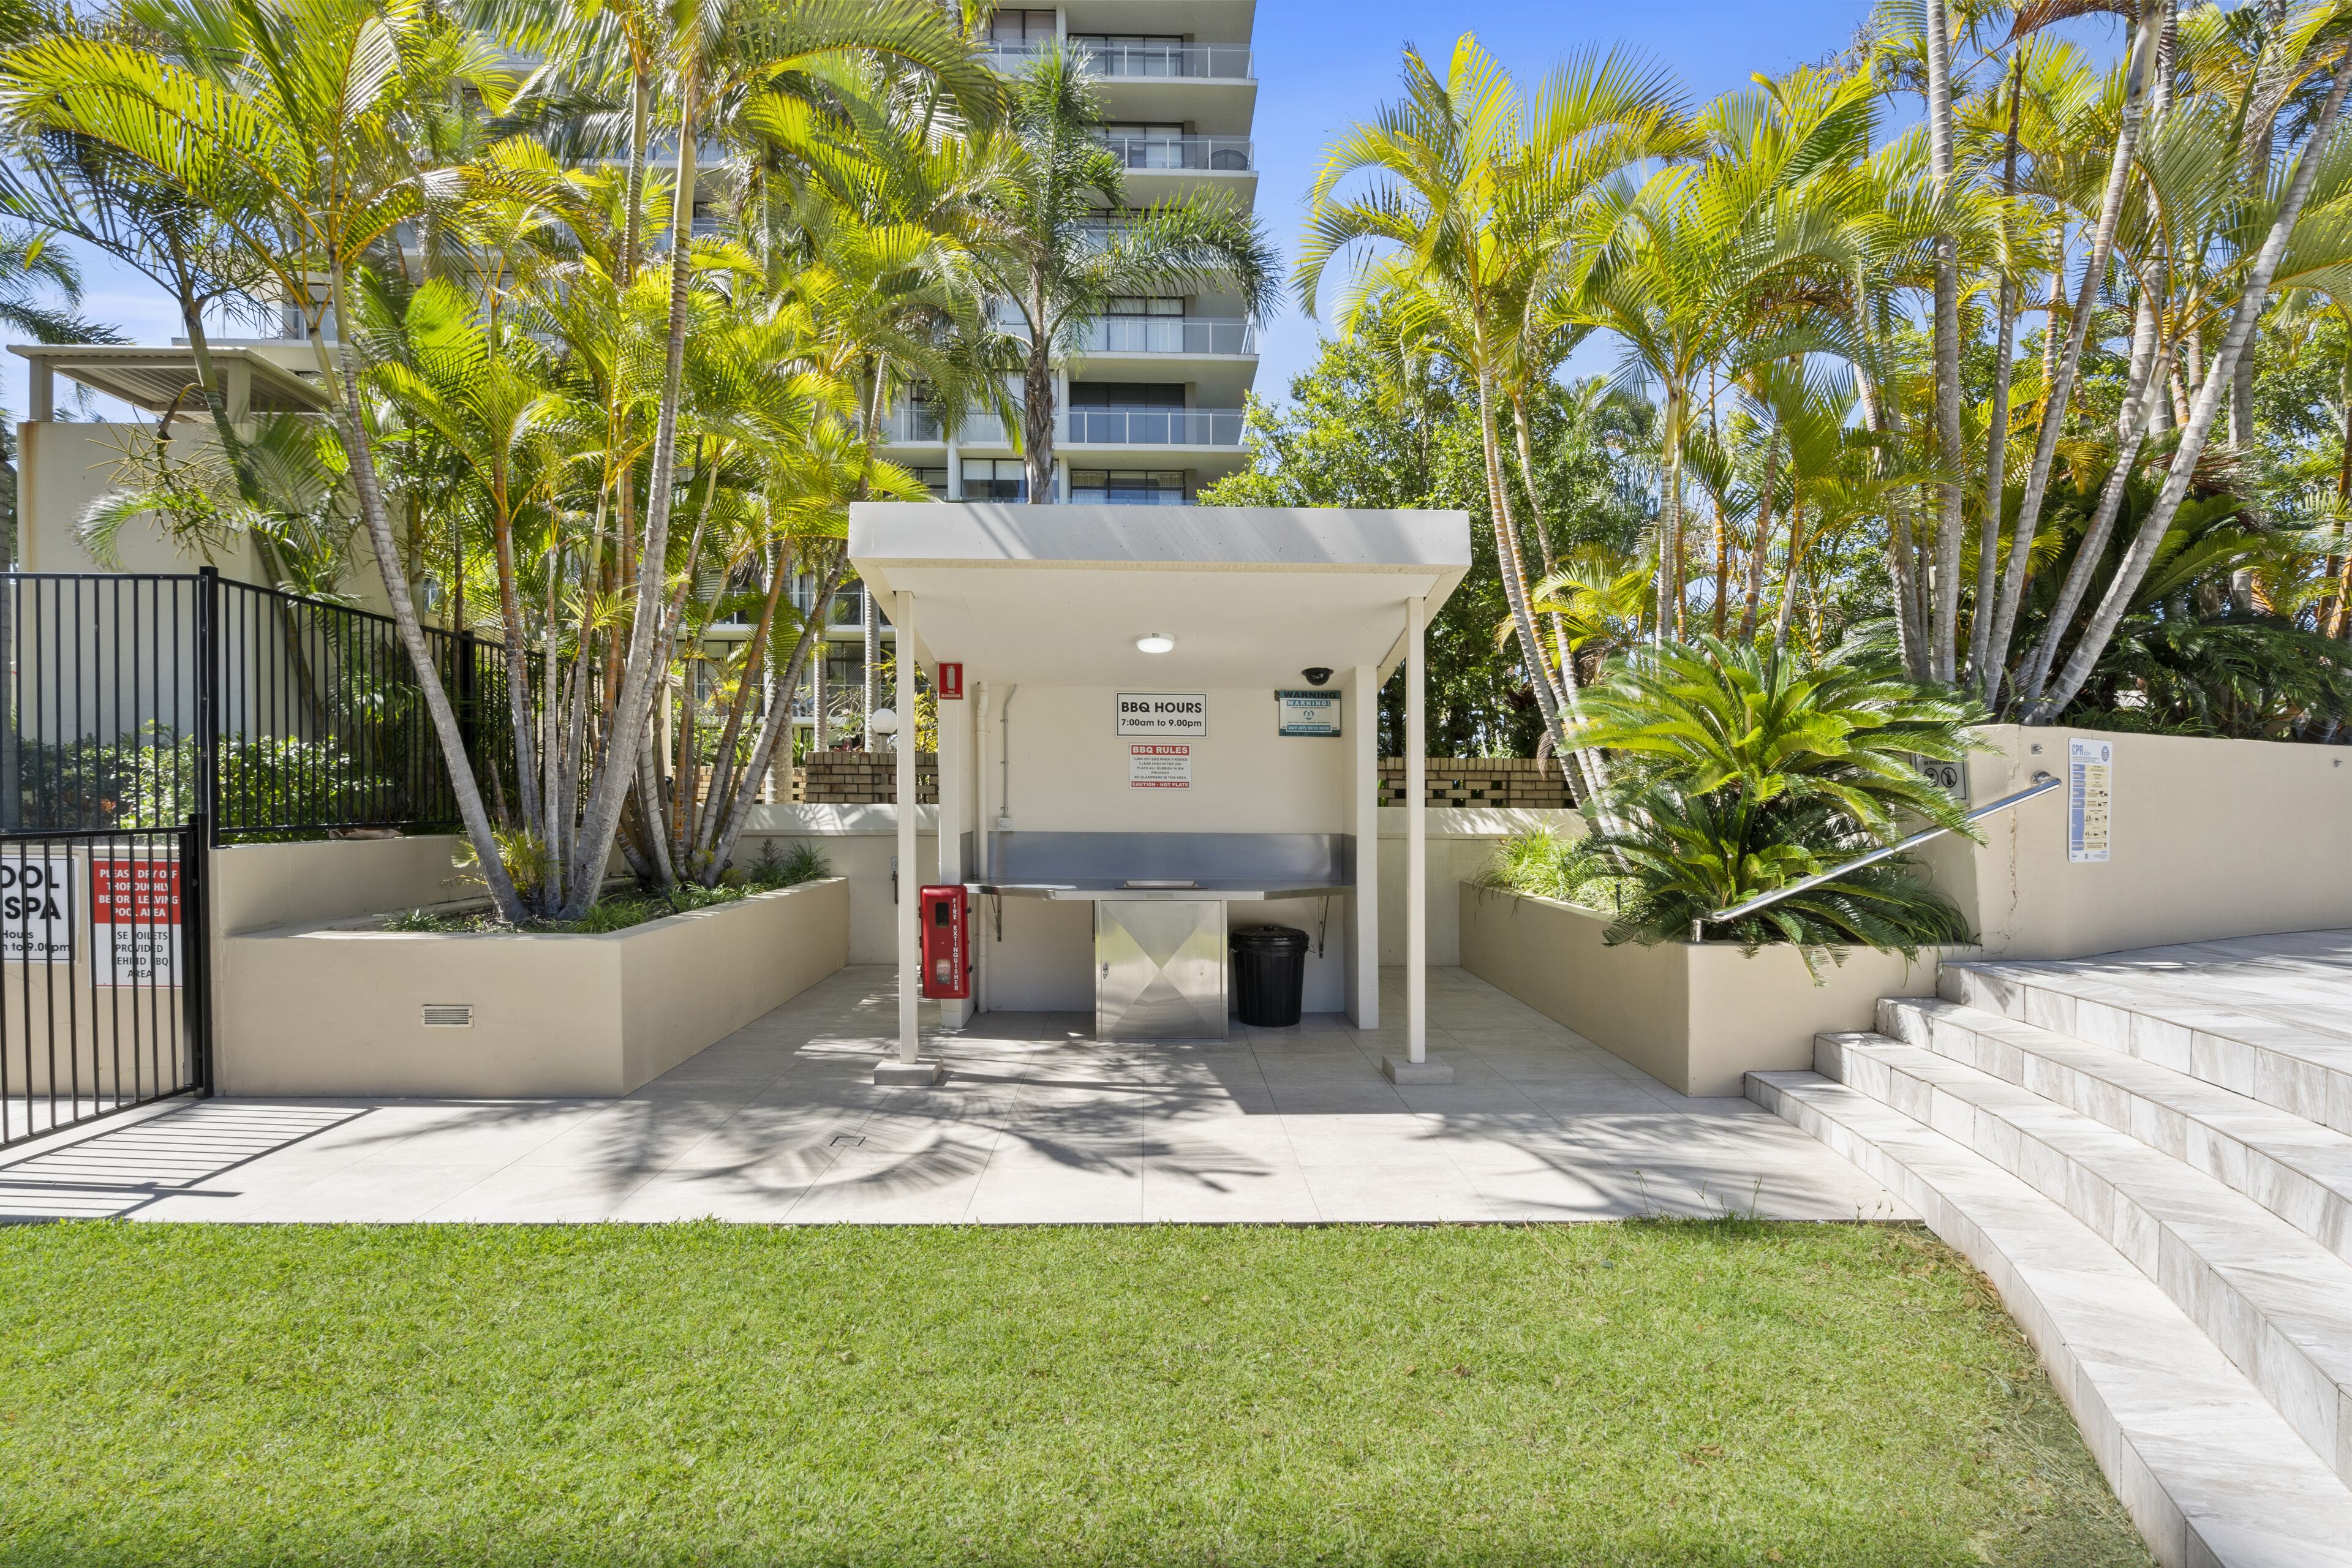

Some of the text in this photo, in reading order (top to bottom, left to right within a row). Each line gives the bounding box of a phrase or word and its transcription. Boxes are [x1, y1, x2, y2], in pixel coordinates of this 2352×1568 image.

[1121, 702, 1202, 713] BBQ HOURS
[1169, 719, 1202, 728] 9.00pm
[2072, 744, 2083, 755] CPR
[100, 869, 130, 878] PLEAS
[99, 895, 131, 903] BEOR
[4, 896, 62, 919] SPA
[141, 908, 166, 917] AEA
[2, 930, 34, 939] Hous
[12, 942, 23, 951] to
[156, 957, 168, 967] BQ
